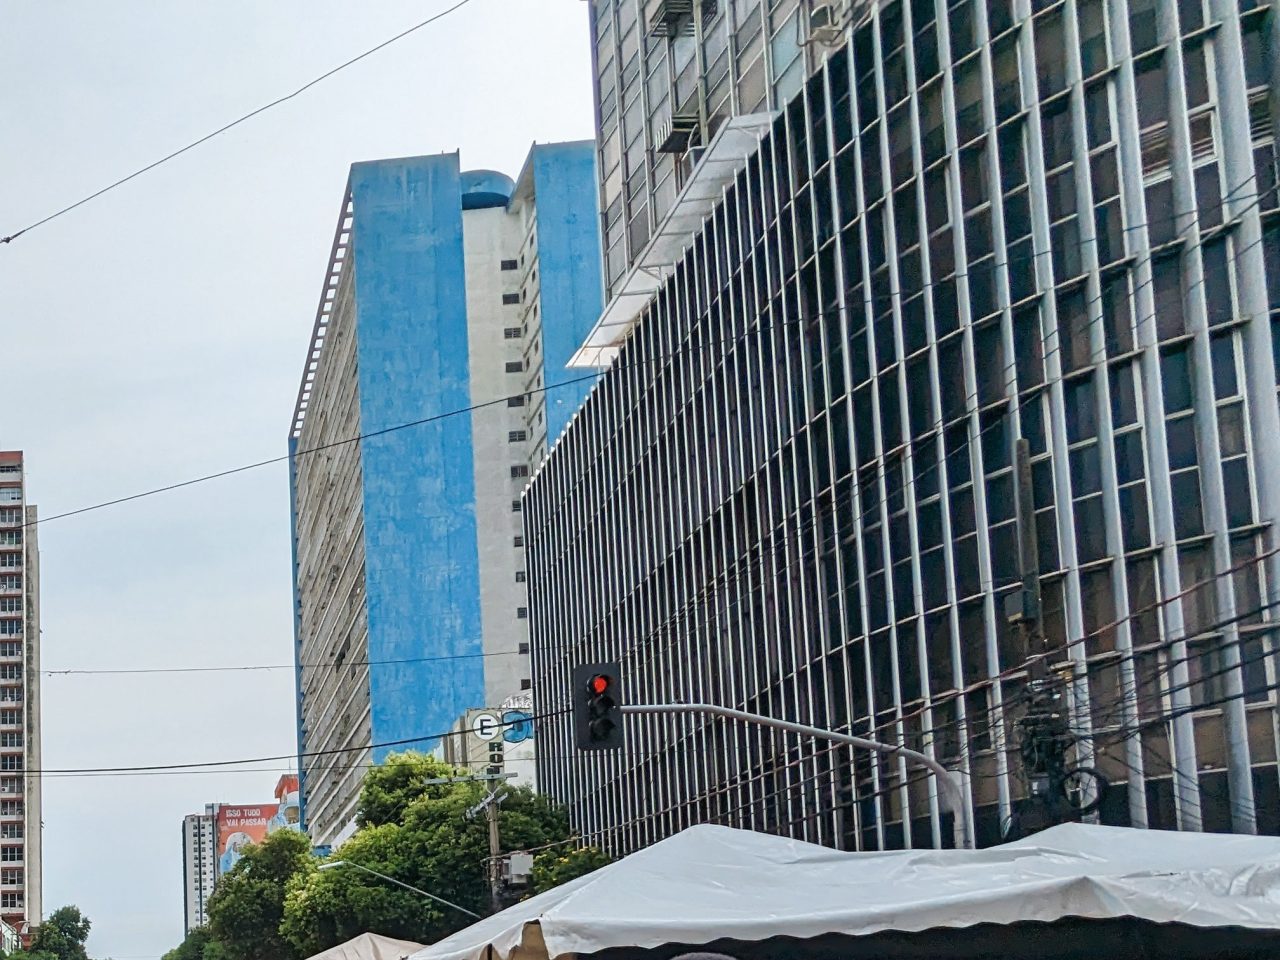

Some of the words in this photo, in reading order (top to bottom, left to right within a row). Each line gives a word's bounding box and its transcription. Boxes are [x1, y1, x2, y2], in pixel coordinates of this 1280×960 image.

[480, 719, 492, 735] E
[225, 809, 240, 817] ISSO
[243, 808, 260, 817] TUDO
[226, 818, 238, 827] VAI
[240, 818, 266, 826] PASSAR
